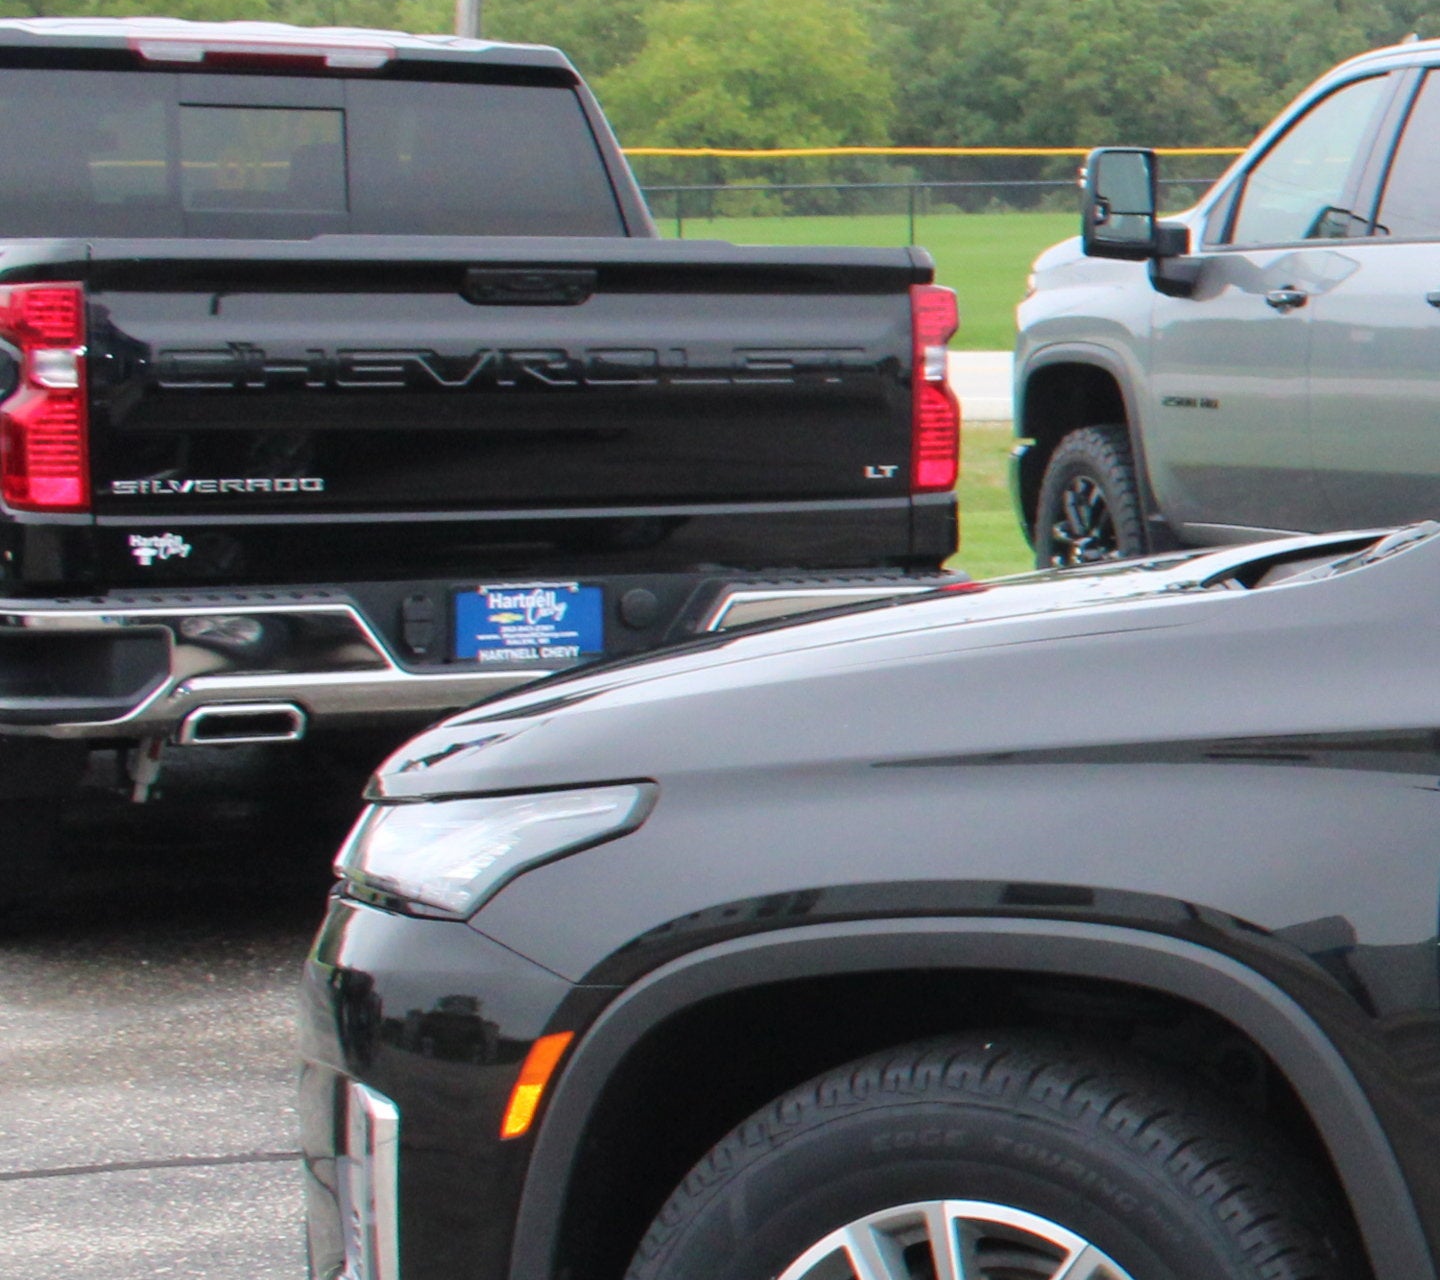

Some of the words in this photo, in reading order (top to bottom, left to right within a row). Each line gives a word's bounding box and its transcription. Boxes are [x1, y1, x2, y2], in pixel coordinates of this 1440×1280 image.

[157, 346, 865, 387] CHEVROLET
[865, 465, 898, 478] LT
[112, 479, 325, 494] SILVERADO
[488, 590, 557, 609] Hartnell
[479, 648, 539, 661] HARTNELL
[540, 646, 580, 658] CHEVY
